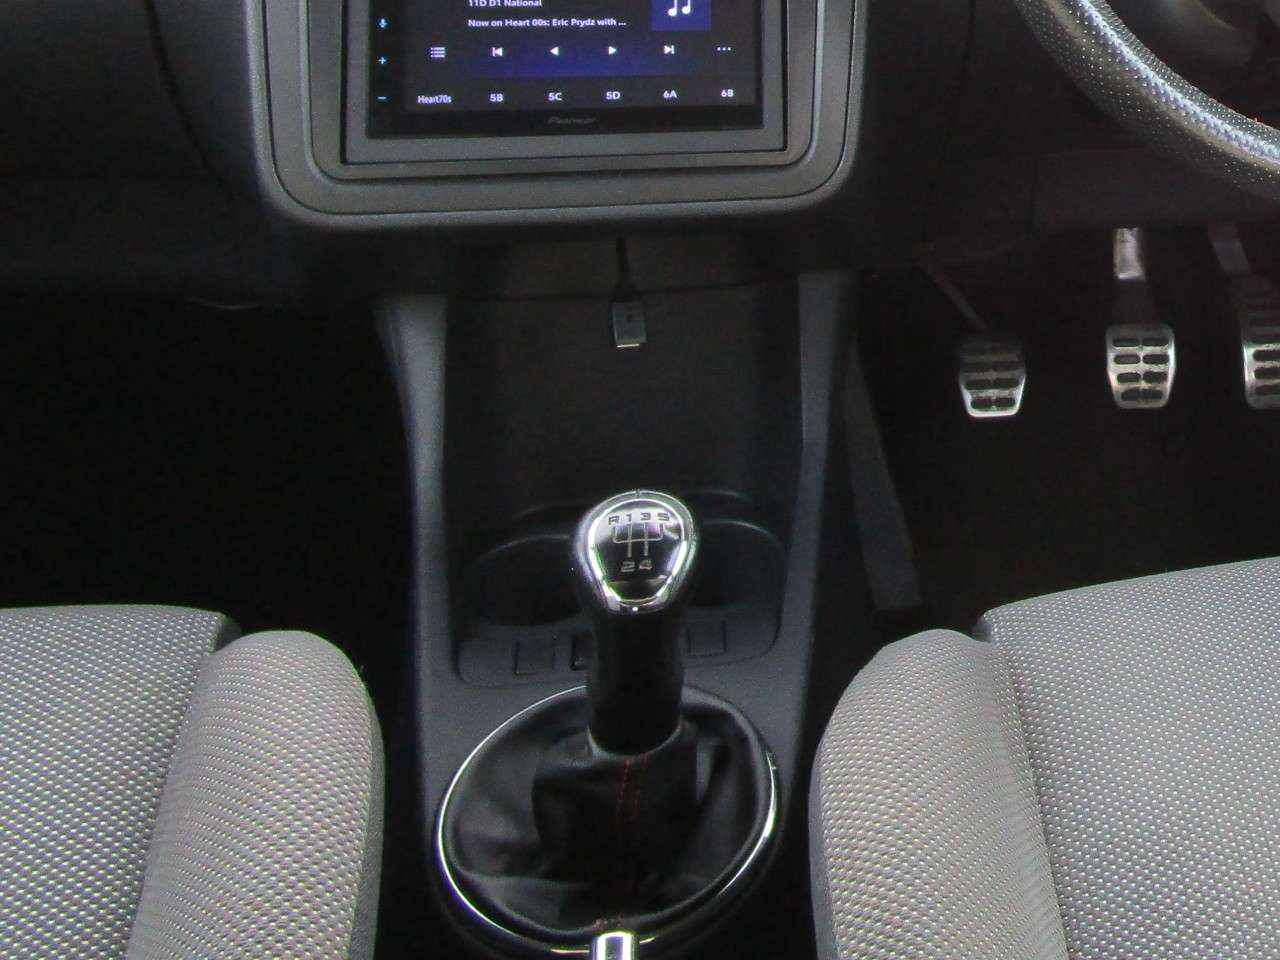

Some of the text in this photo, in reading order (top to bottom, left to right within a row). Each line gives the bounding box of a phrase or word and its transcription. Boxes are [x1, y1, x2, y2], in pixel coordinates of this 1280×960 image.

[468, 0, 487, 7] 11D
[489, 0, 501, 7] D1
[468, 19, 488, 28] Now
[505, 18, 530, 27] Heart
[552, 18, 568, 27] Eric
[571, 18, 594, 29] Prydz
[597, 18, 616, 26] with
[489, 93, 504, 103] 5B
[548, 92, 563, 102] 5C
[606, 90, 621, 100] 5D
[663, 89, 678, 99] 6A
[721, 88, 734, 98] 6B
[608, 515, 620, 525] R
[621, 559, 653, 572] 2 4
